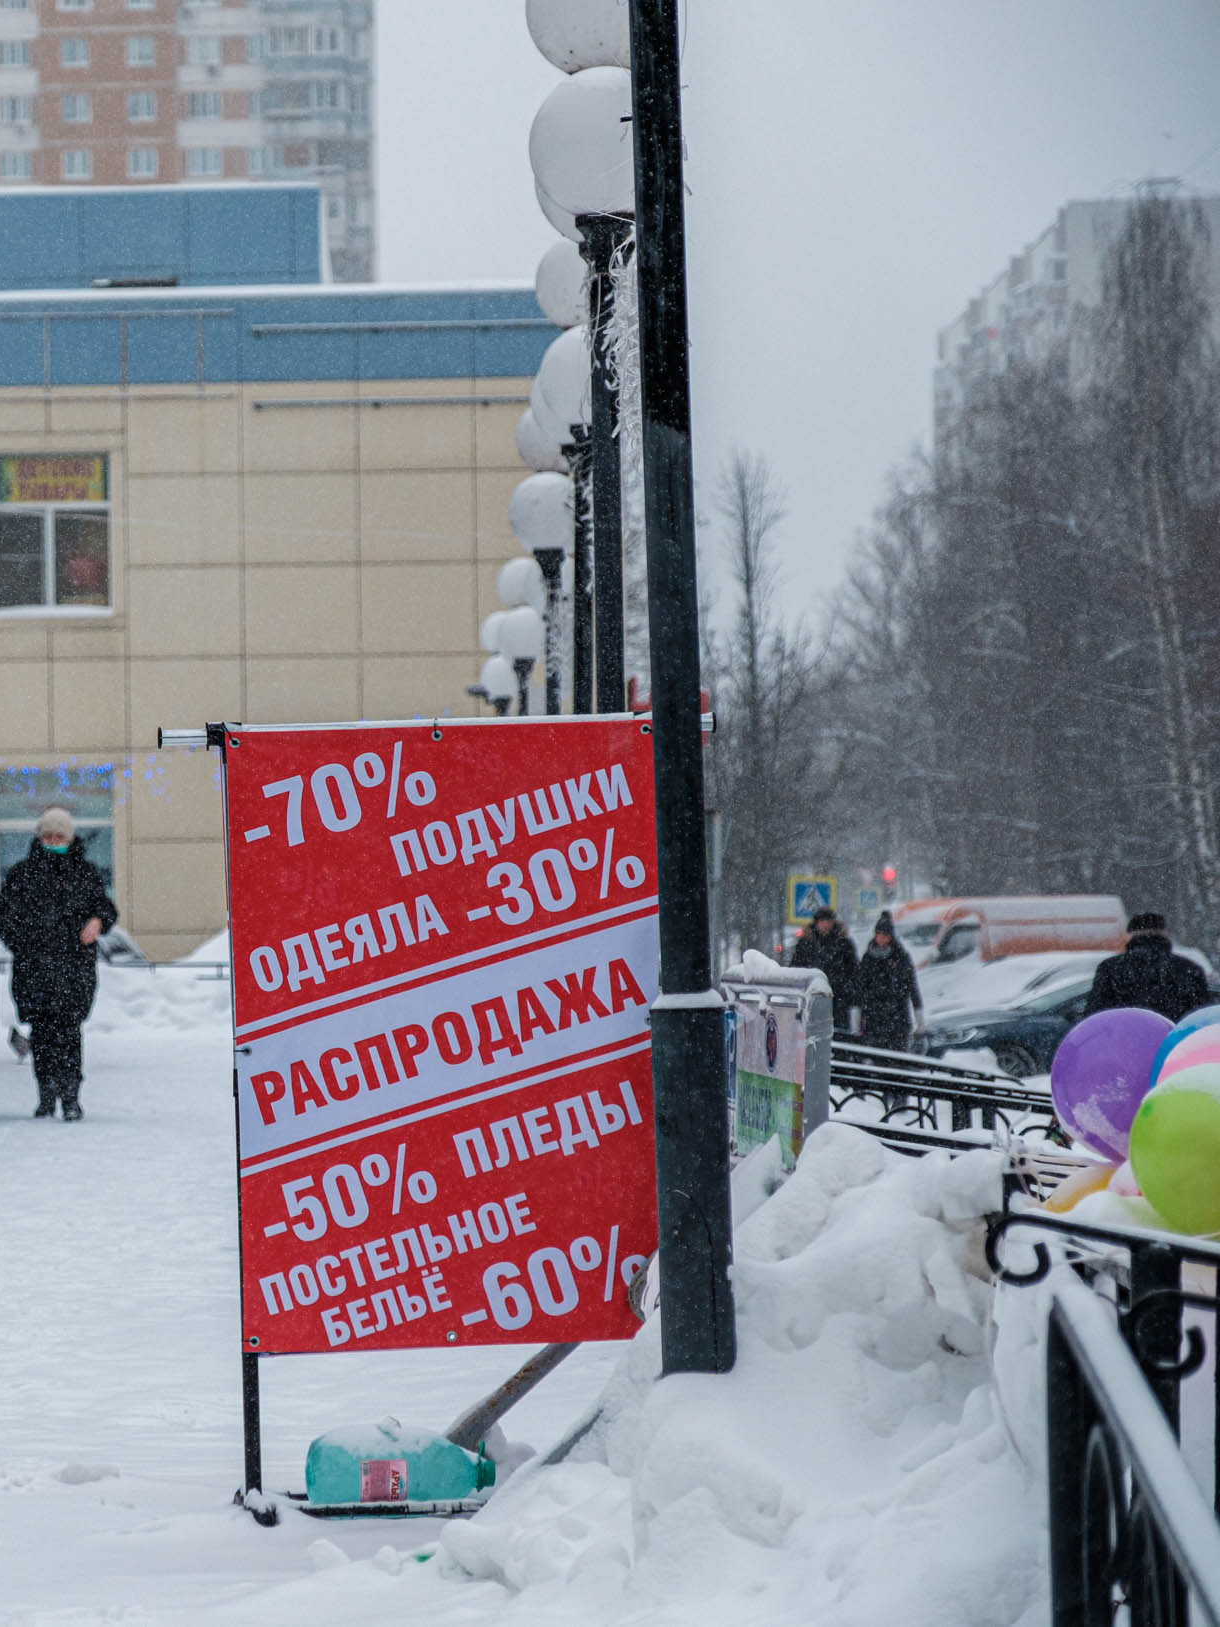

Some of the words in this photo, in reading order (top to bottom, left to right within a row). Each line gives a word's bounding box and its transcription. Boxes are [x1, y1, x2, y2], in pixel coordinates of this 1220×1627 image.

[244, 741, 436, 847] -70%
[390, 764, 633, 877] ПОДУШКИ
[250, 894, 449, 992] ОДЕЯЛА
[467, 828, 645, 926] -30%
[251, 957, 647, 1125] РАСПРОДАЖА
[264, 1143, 437, 1242] -50%
[453, 1080, 642, 1178] ПЛЕДЫ
[259, 1193, 536, 1315] ПОСТЕЛЬНОЕ
[321, 1267, 452, 1346] БЕЛЬЁ
[462, 1225, 647, 1331] -60%
[390, 1469, 400, 1500] АРХЫЗ
